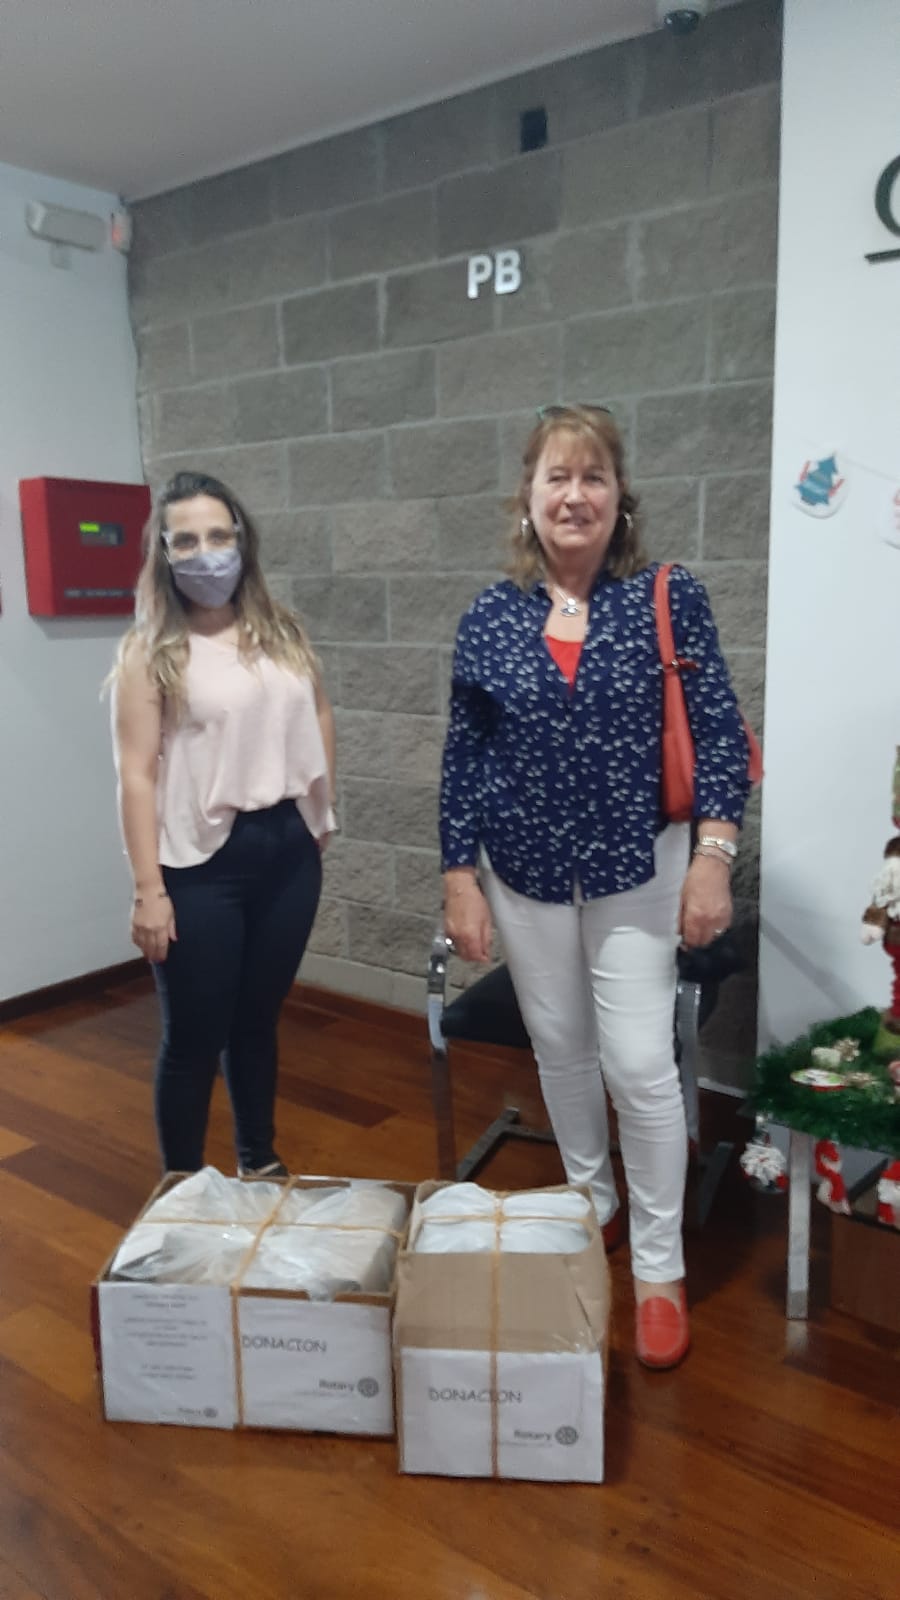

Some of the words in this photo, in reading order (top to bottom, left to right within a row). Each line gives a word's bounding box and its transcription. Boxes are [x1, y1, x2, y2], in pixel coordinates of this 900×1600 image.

[467, 249, 521, 299] PB
[242, 1335, 327, 1353] DONACION
[319, 1378, 355, 1393] Rotary
[428, 1387, 522, 1404] DONACON
[514, 1428, 551, 1441] Rotary
